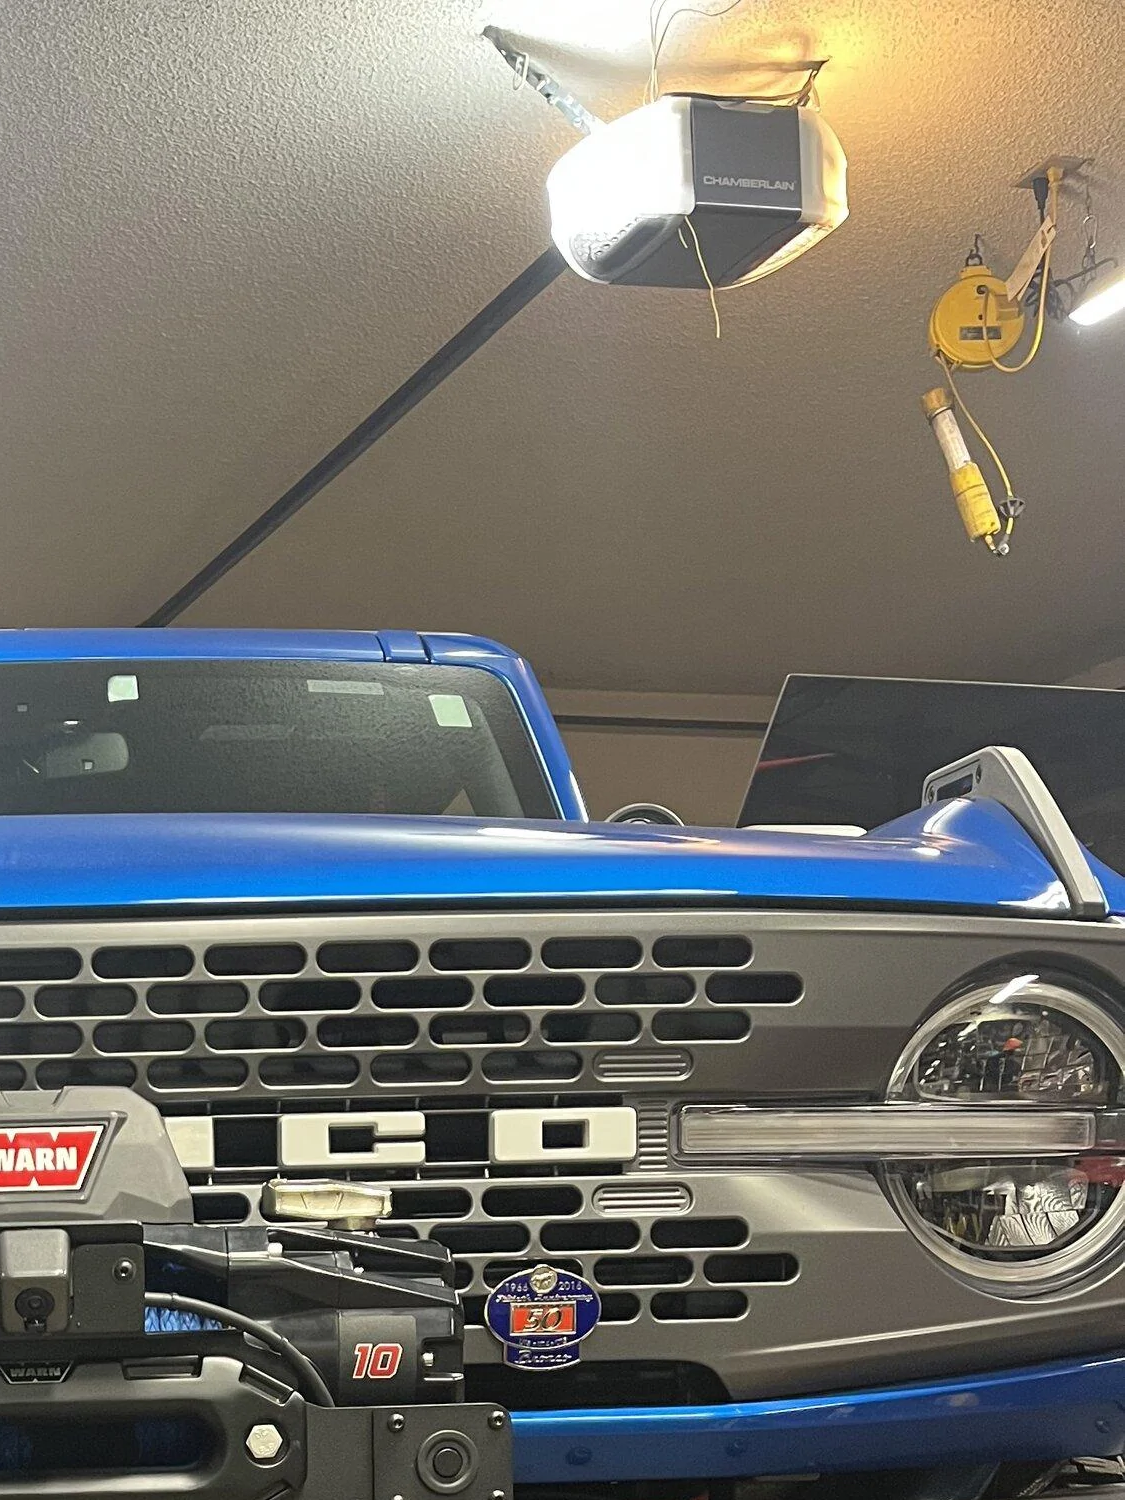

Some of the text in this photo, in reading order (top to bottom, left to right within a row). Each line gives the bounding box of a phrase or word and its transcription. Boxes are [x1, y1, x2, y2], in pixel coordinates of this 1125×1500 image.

[703, 175, 795, 191] CHAMBERLAIN
[522, 1307, 563, 1331] 50
[352, 1343, 404, 1379] 10
[10, 1367, 61, 1377] WARN
